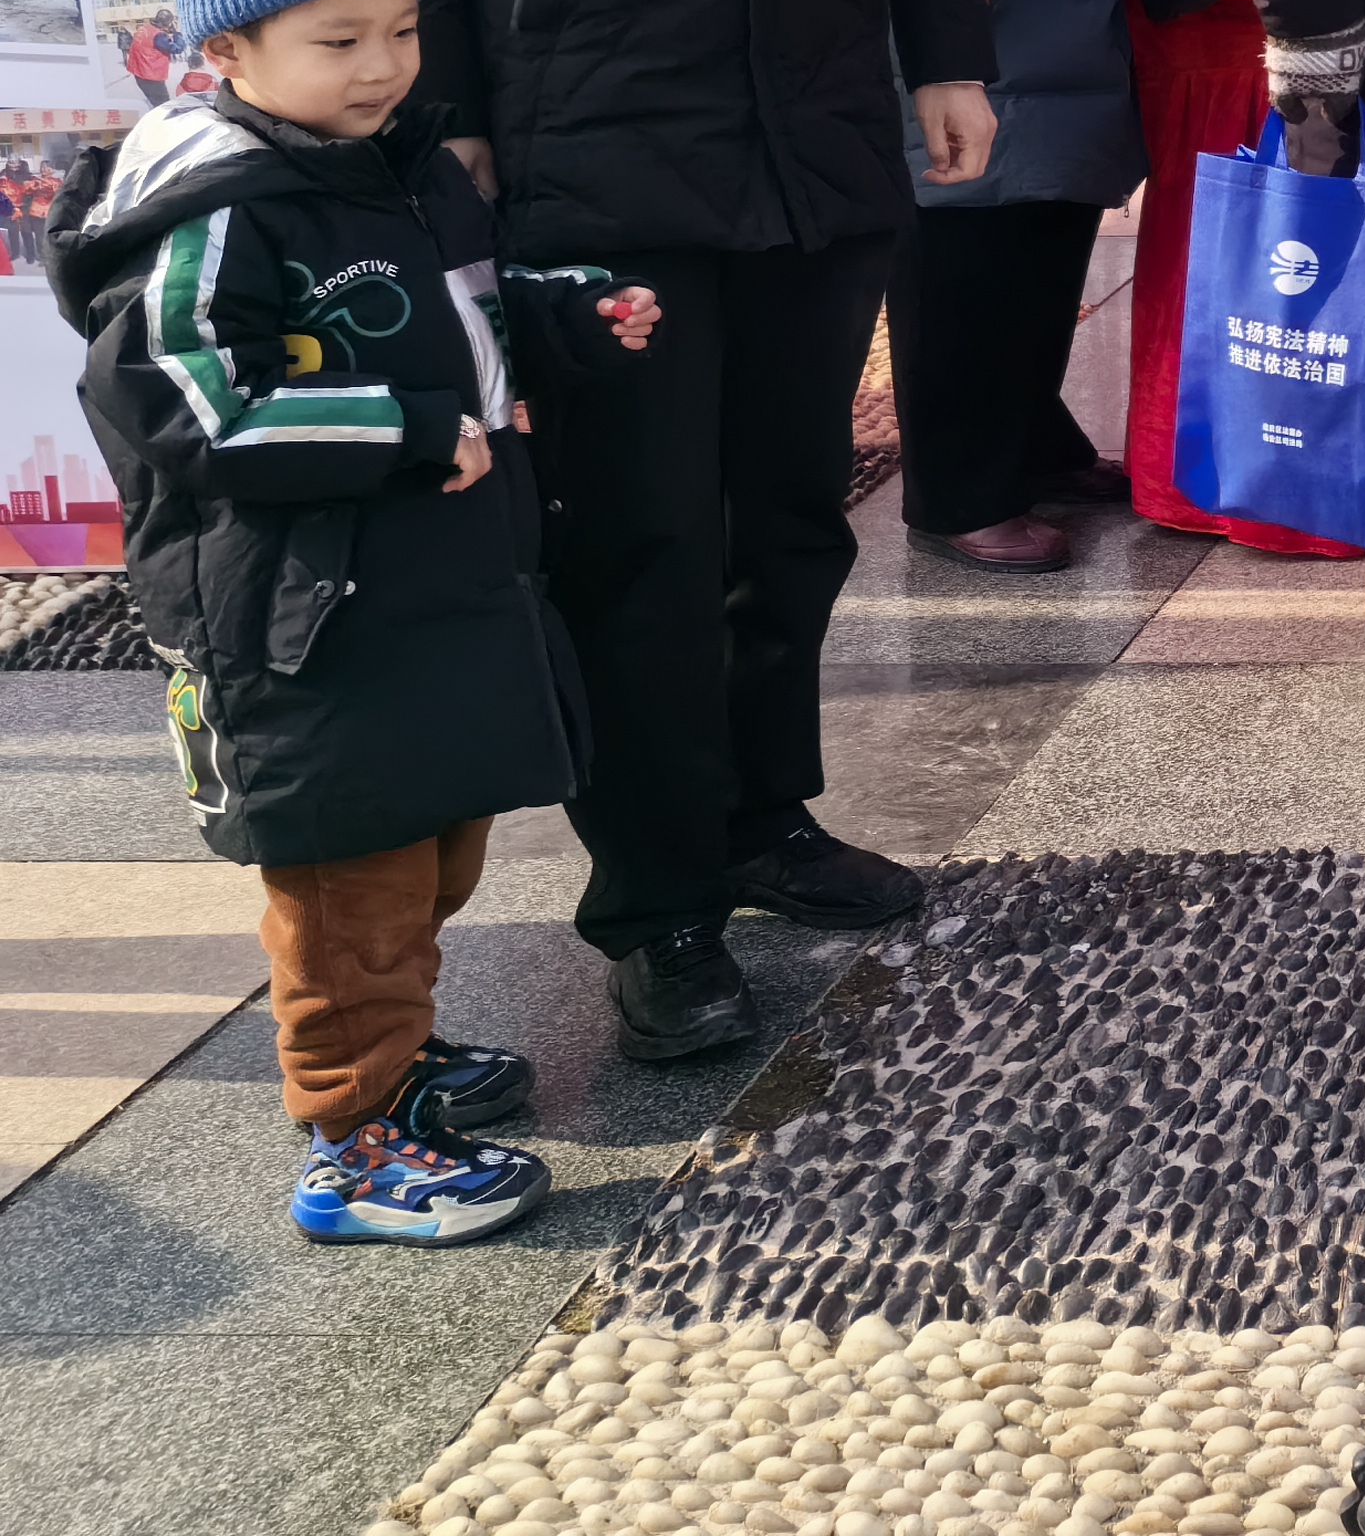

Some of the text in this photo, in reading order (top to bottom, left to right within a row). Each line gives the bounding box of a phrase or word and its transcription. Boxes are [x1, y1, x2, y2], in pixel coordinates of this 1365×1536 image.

[313, 260, 399, 299] SPORTIVE
[1228, 316, 1349, 358] 弘扬宪法精神
[1228, 342, 1346, 386] 推进依法治国
